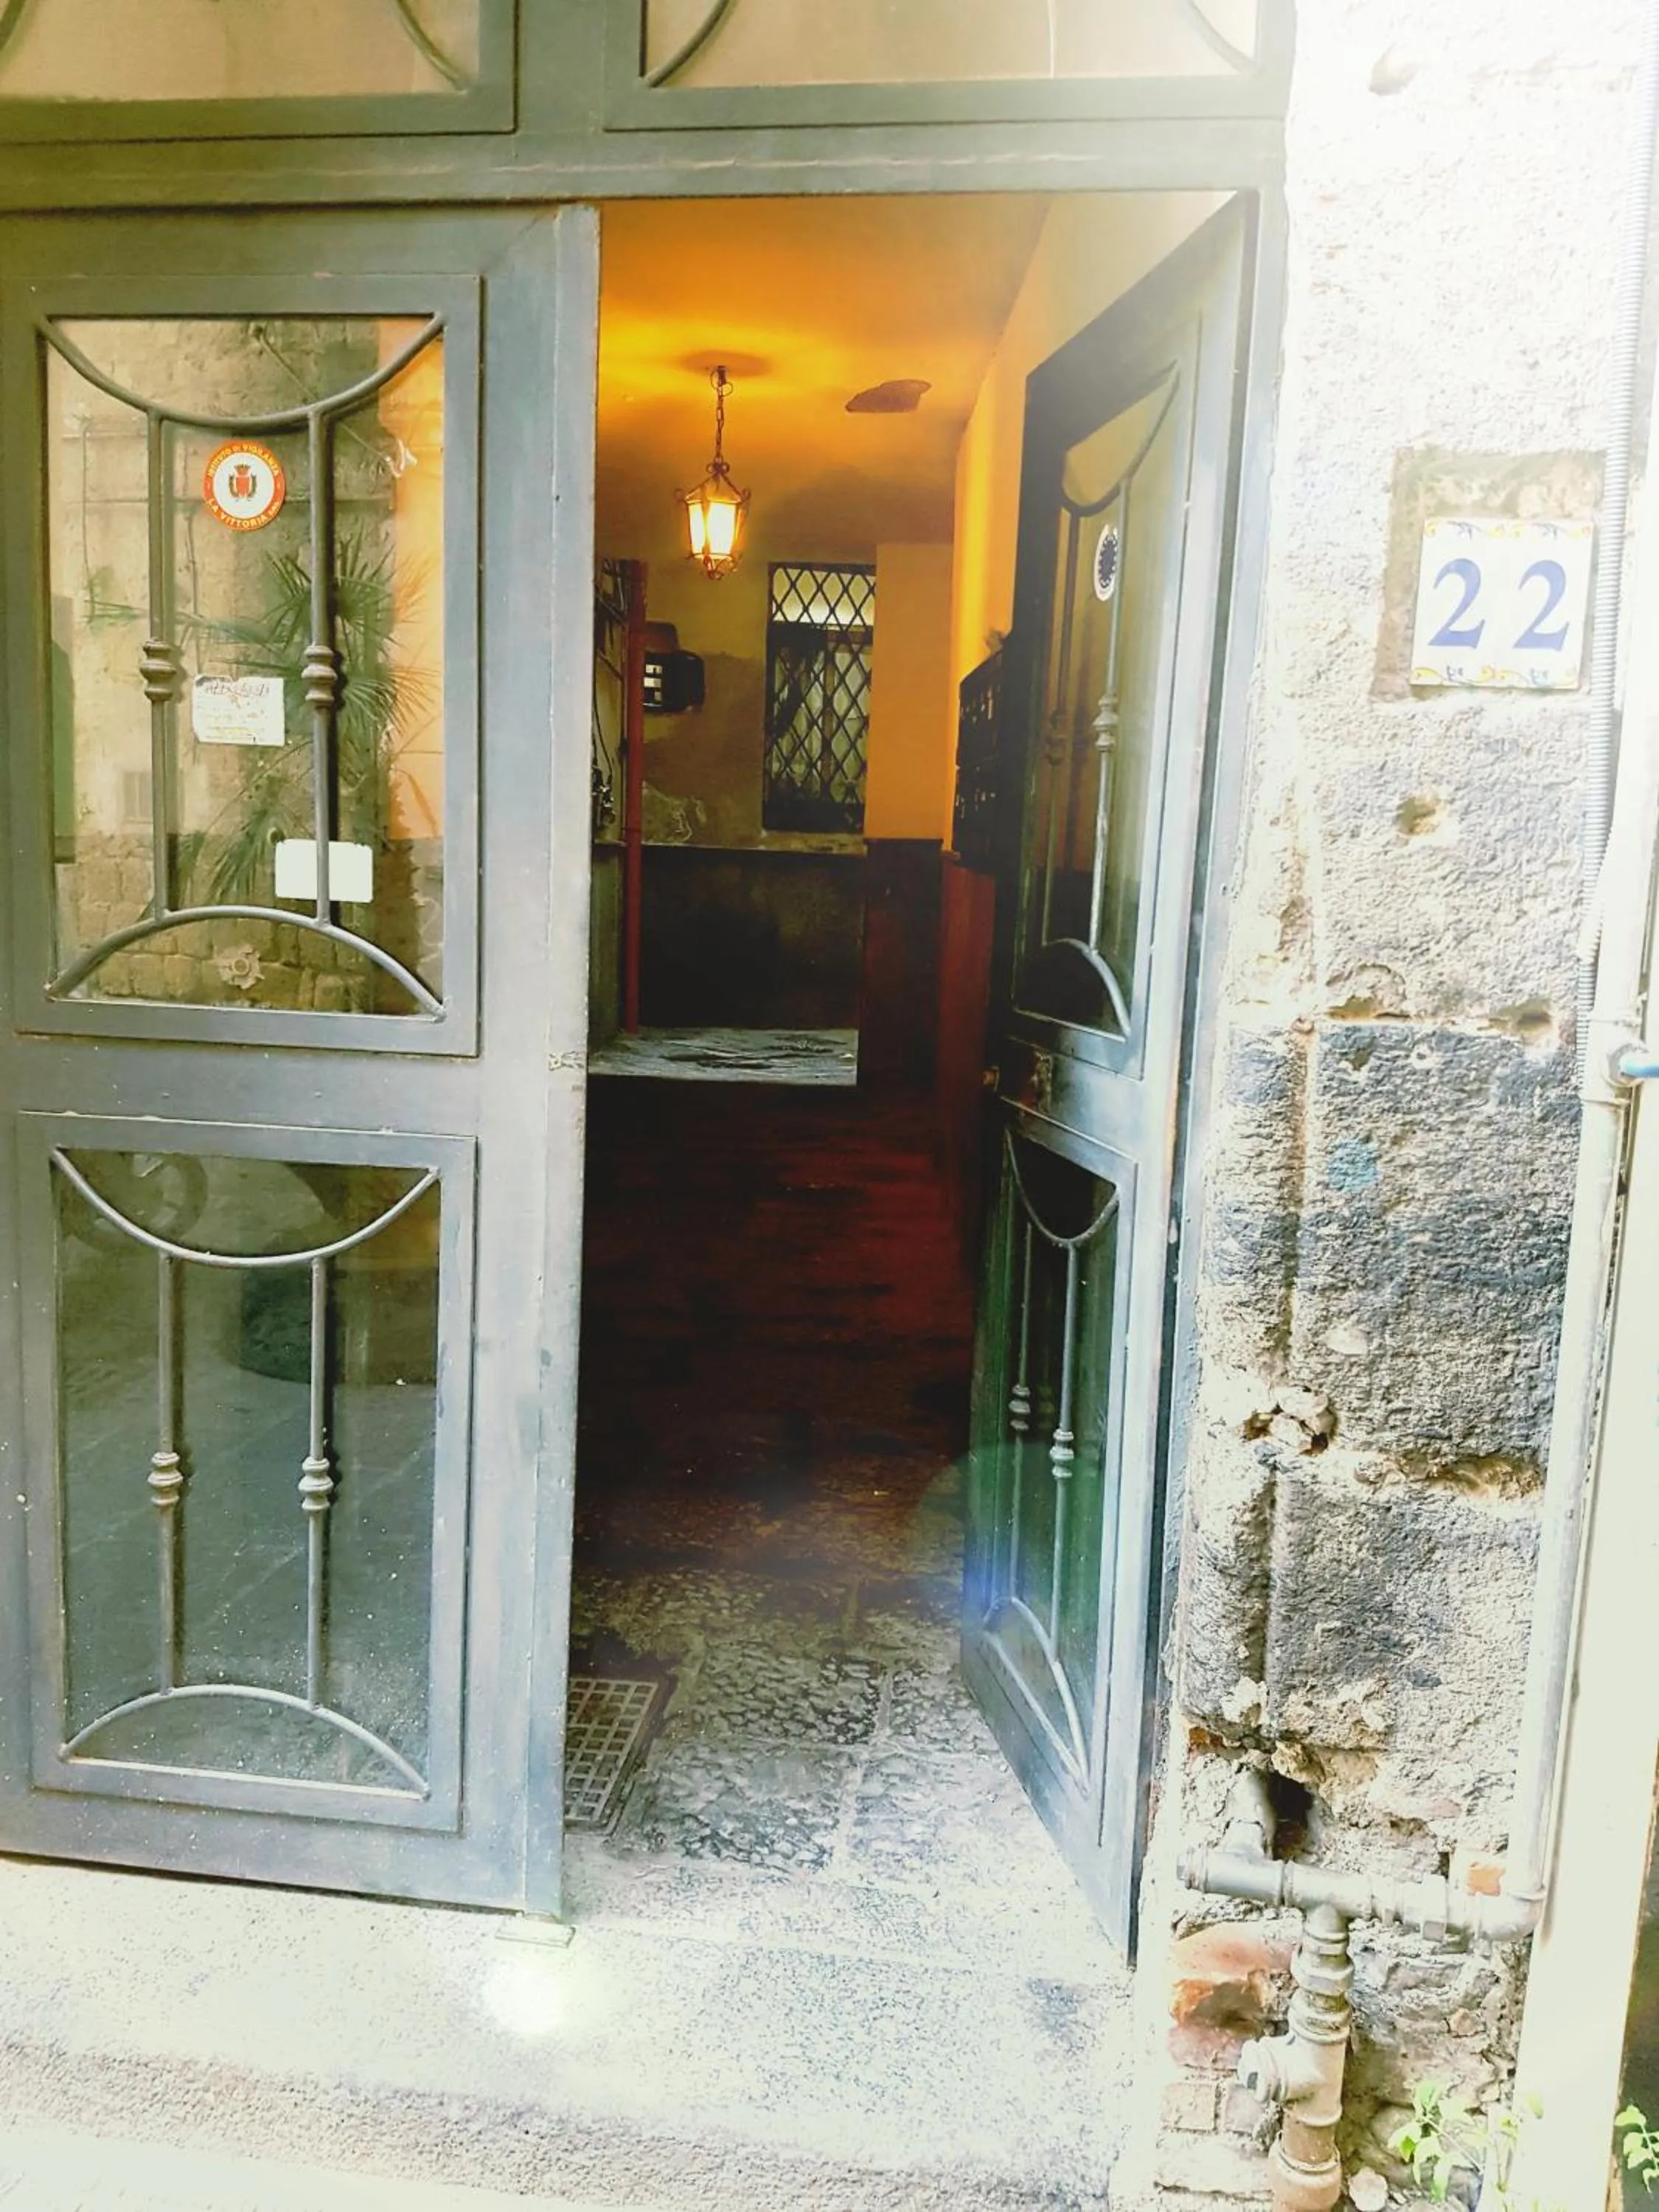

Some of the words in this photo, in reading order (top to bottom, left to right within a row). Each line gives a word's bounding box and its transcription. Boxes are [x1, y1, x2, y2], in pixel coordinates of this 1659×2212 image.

[209, 498, 219, 512] LA
[220, 513, 268, 528] VITTORIA
[1427, 557, 1570, 652] 22
